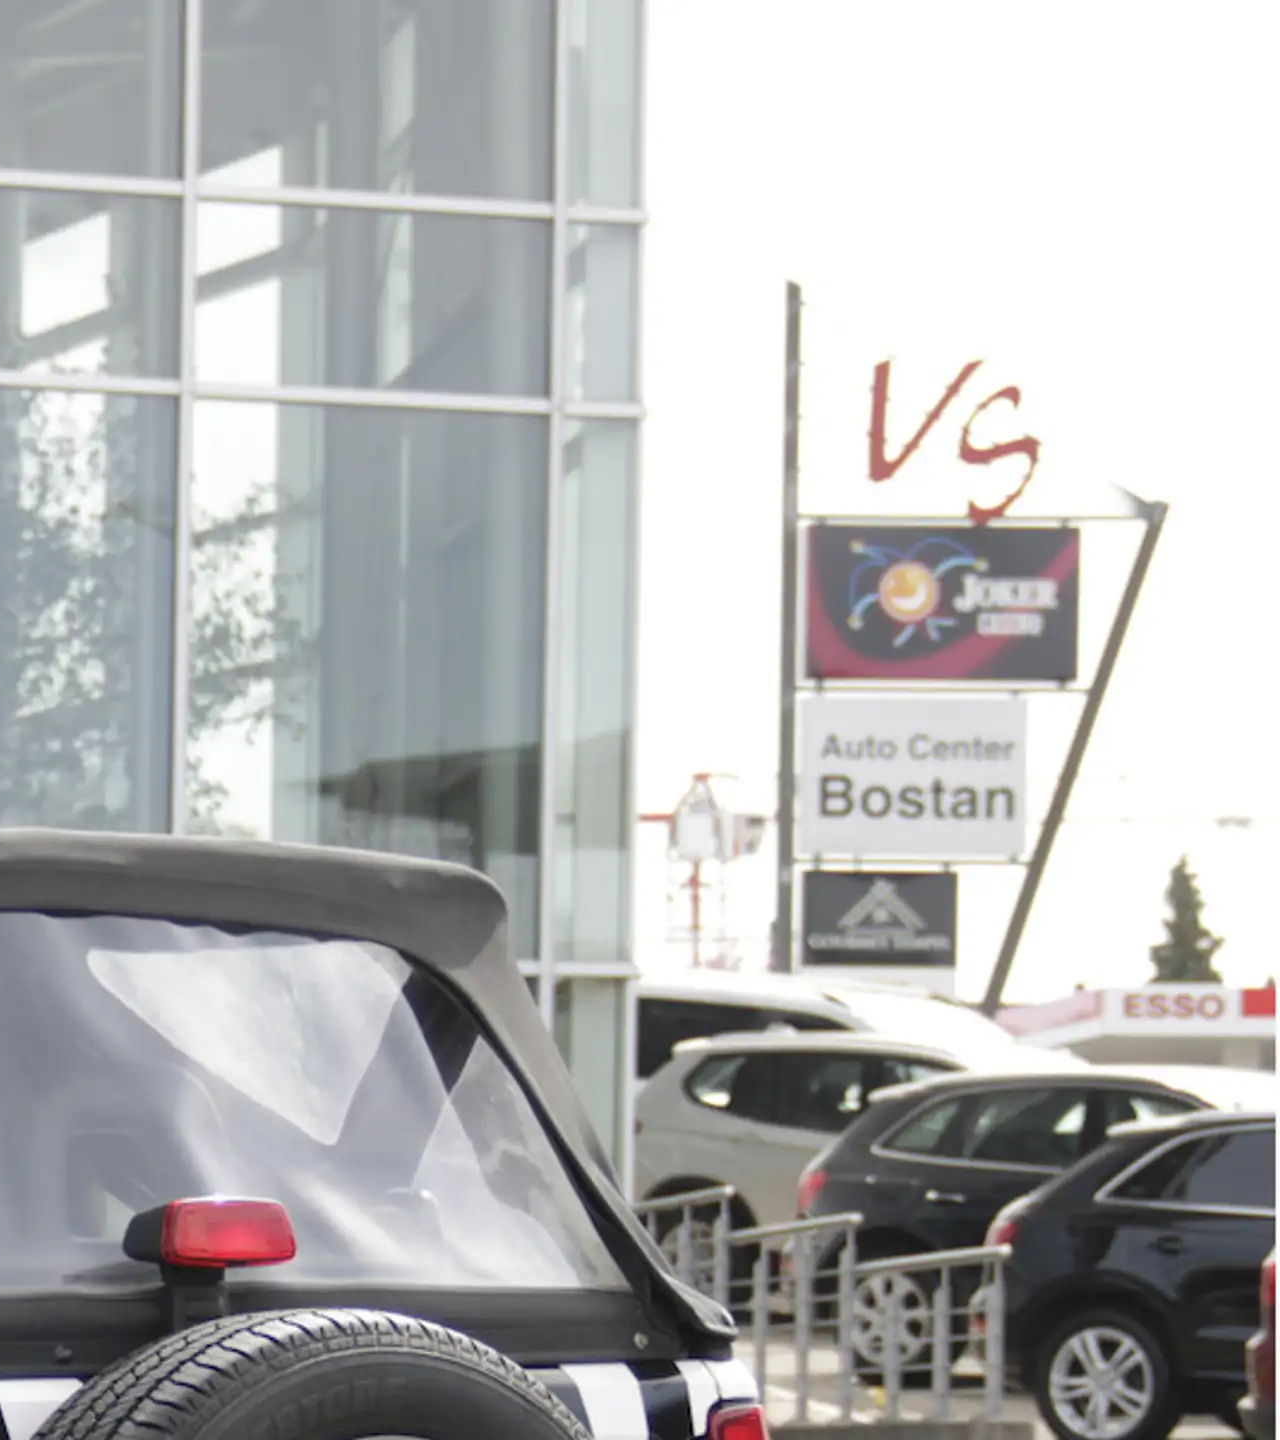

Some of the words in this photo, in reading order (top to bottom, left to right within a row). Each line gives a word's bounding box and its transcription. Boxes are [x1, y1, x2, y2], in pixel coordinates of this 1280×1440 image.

[866, 359, 1042, 528] VS
[820, 732, 898, 760] Auto
[907, 732, 1016, 762] Center
[817, 773, 1016, 821] Bostan
[1123, 992, 1227, 1021] ESSO
